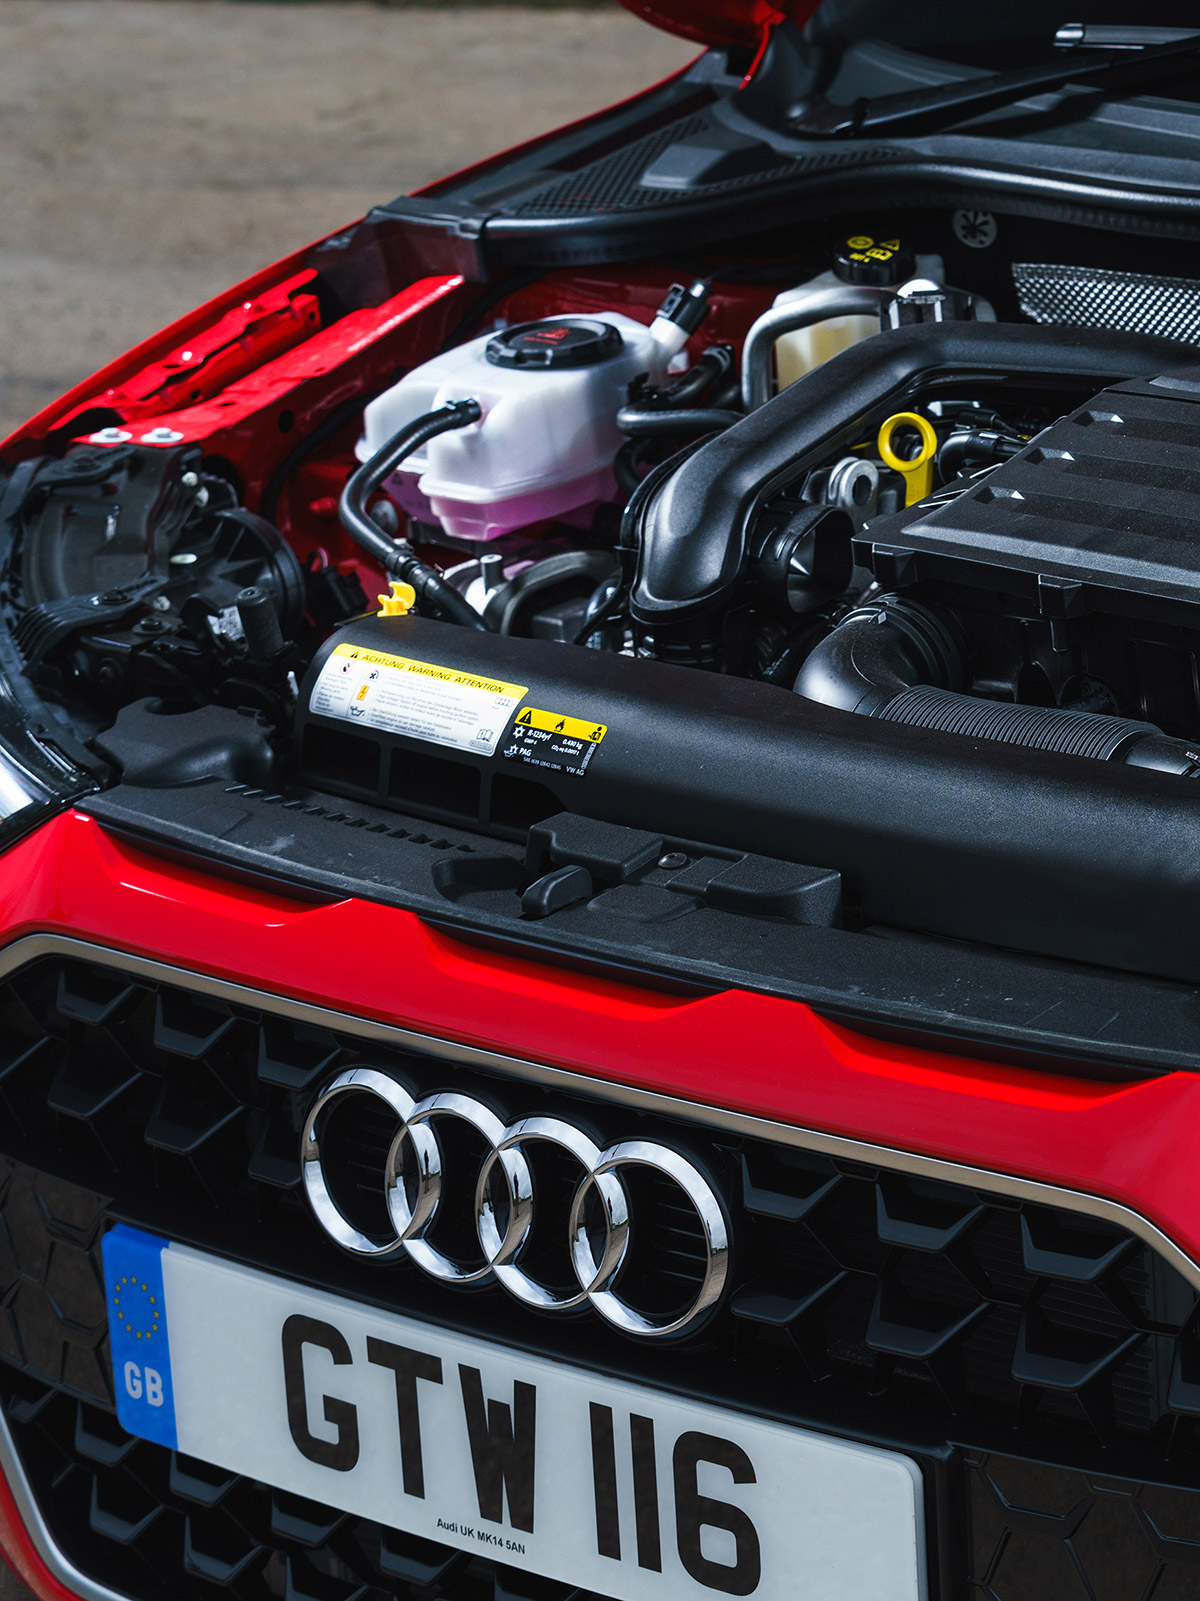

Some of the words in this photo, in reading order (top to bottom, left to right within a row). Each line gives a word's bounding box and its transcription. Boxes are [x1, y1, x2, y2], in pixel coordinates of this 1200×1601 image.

[362, 654, 405, 670] ACHTUNG
[408, 664, 452, 681] WARNING
[454, 676, 505, 693] ATTENTION
[519, 747, 532, 756] PAG
[576, 768, 584, 776] AG
[124, 1361, 164, 1407] GB
[281, 1313, 537, 1535] GTW
[588, 1400, 762, 1597] 116
[437, 1518, 458, 1533] Audi
[460, 1525, 475, 1538] UK
[478, 1530, 503, 1547] MK14
[506, 1540, 526, 1554] 5AN
